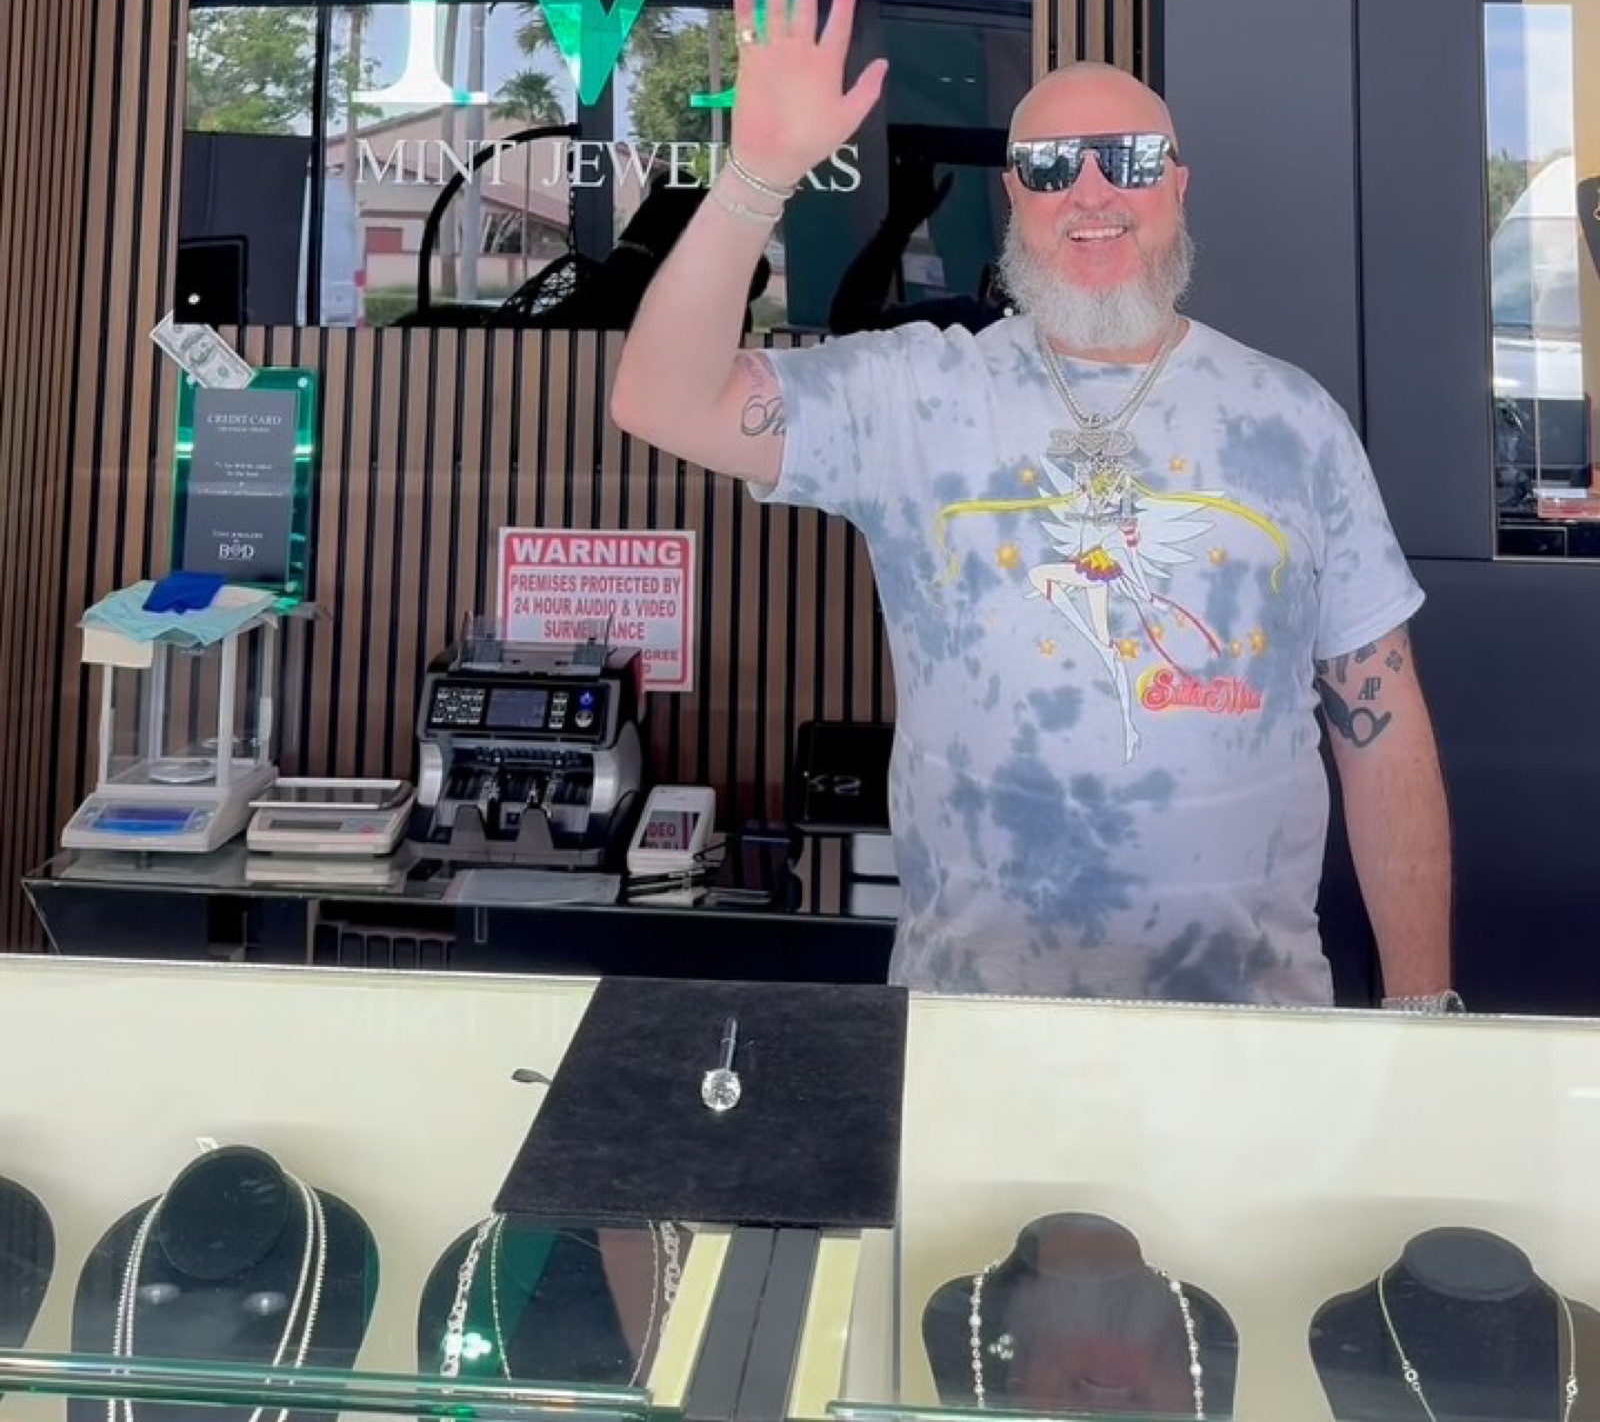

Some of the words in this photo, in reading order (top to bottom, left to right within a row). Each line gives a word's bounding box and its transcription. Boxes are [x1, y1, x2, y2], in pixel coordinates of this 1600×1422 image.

[355, 139, 507, 184] MINT
[541, 141, 862, 193] JEWELS
[511, 537, 682, 566] WARNING
[510, 573, 576, 592] PREMISES
[580, 575, 659, 594] PROTECTED
[664, 577, 681, 594] BY
[513, 597, 530, 614] 24
[533, 598, 572, 615] HOUR
[575, 599, 616, 616] AUDIO
[621, 600, 630, 616] &
[636, 601, 676, 618] VIDEO
